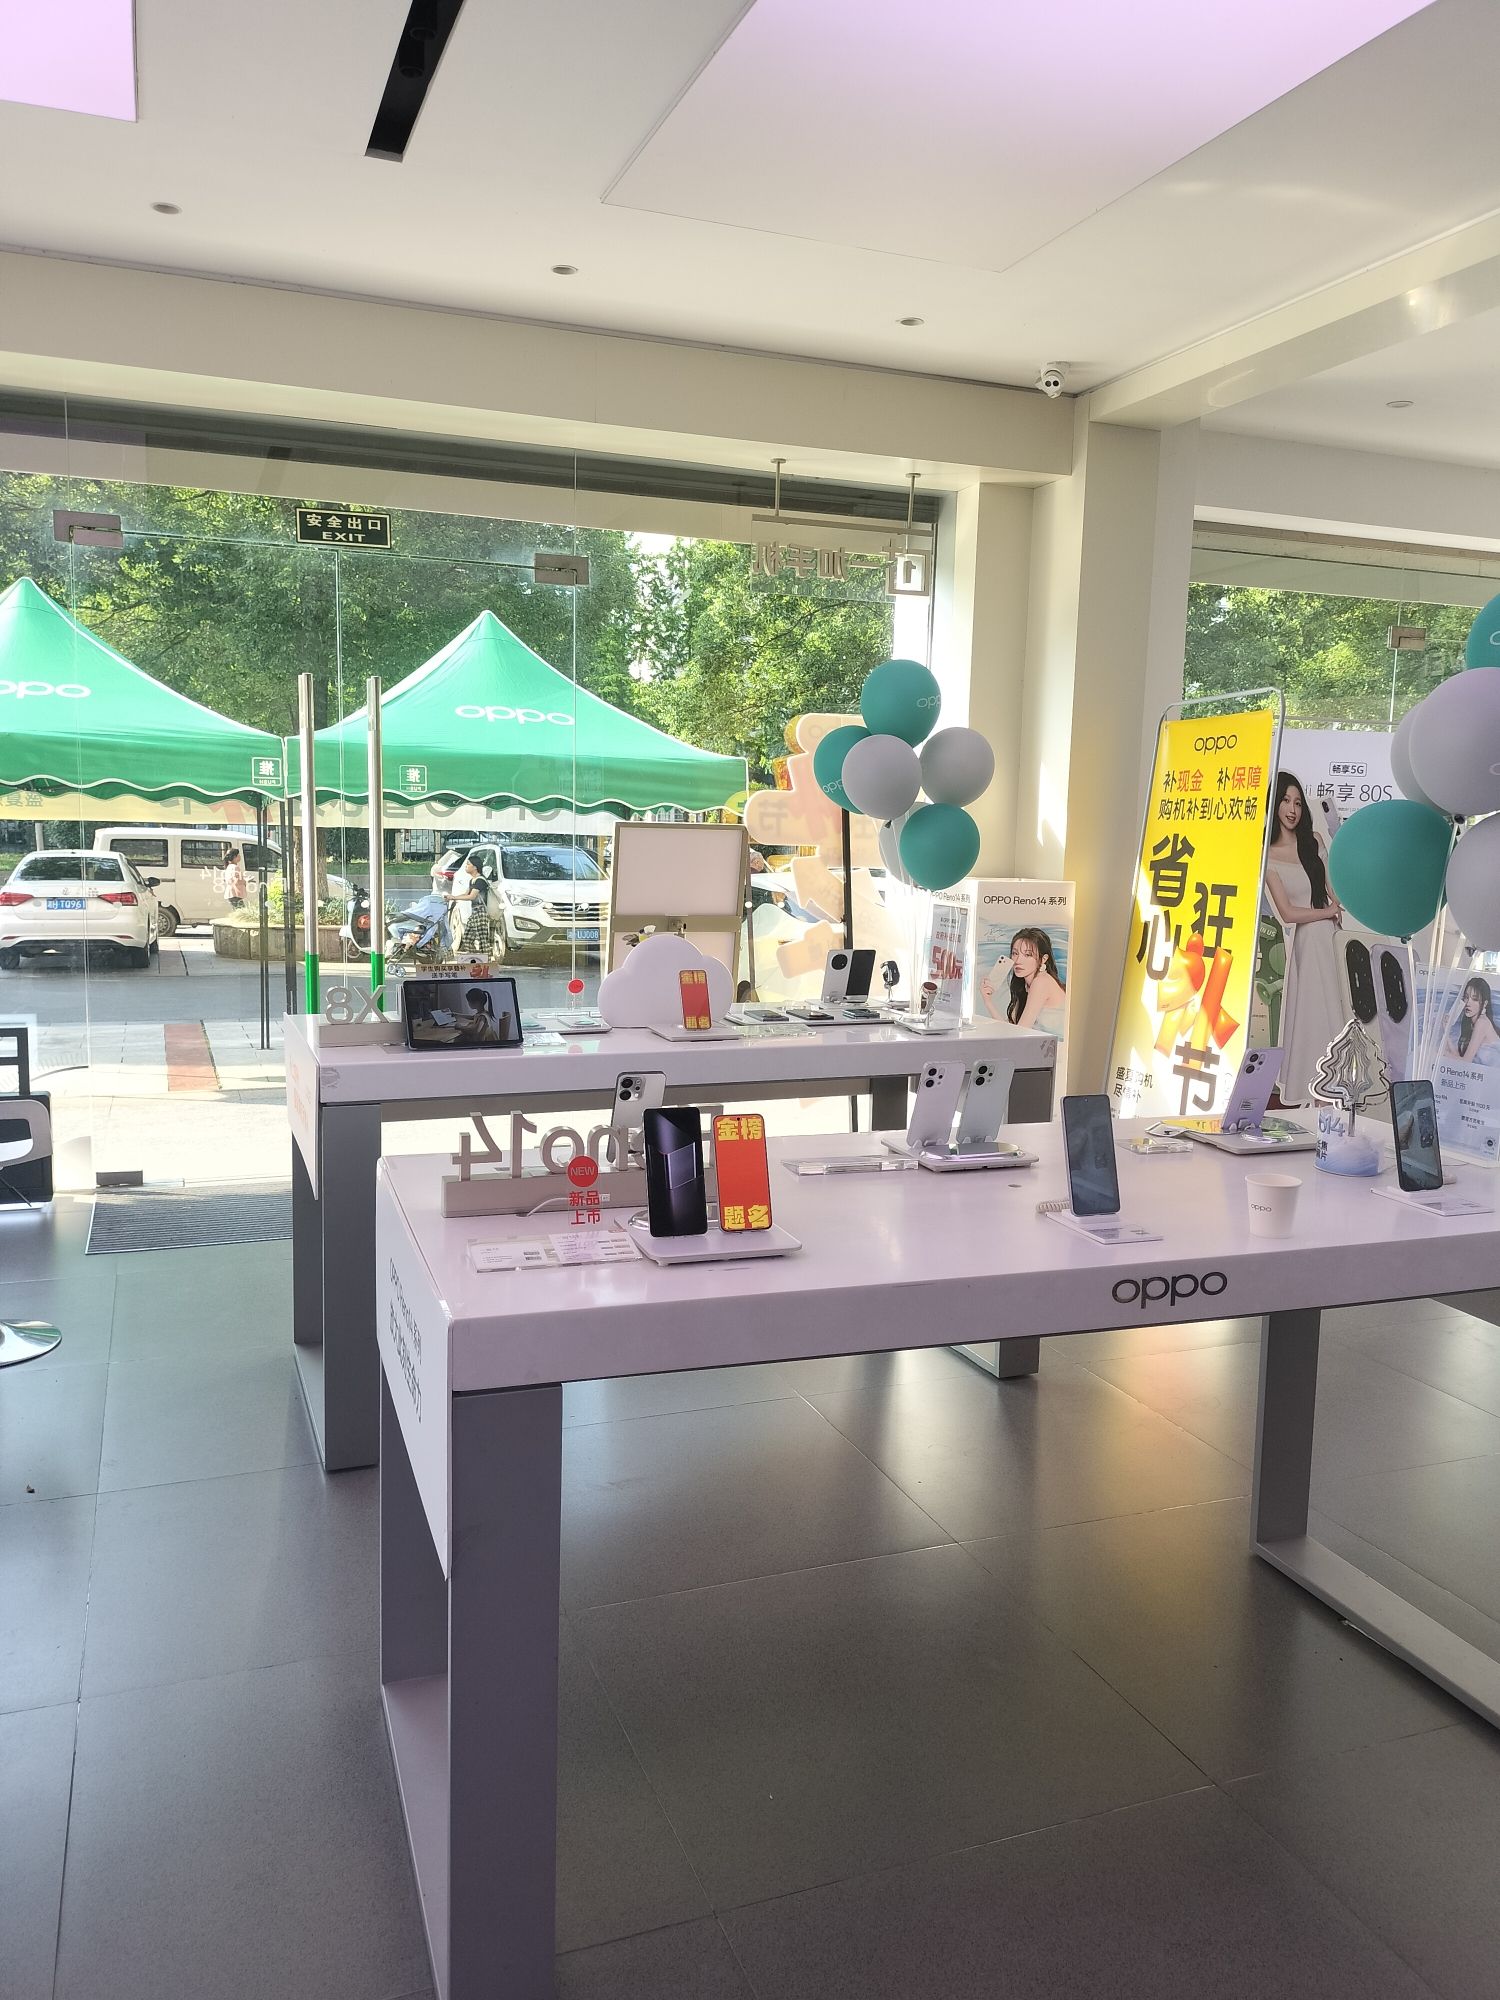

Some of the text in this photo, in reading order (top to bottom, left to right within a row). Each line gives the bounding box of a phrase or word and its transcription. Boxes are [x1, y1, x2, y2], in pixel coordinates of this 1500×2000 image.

[306, 514, 381, 530] 安全出口
[322, 532, 365, 542] EXIT
[1163, 765, 1262, 793] 补现金 补保障
[1317, 782, 1356, 802] 畅享
[1360, 784, 1393, 802] 80S
[1157, 796, 1258, 821] 购机补到心欢畅
[983, 895, 1067, 906] OPPO Reno14 系列
[1441, 1078, 1467, 1091] 新品上市
[718, 1116, 765, 1143] 金榜
[570, 1166, 595, 1177] NEW
[569, 1190, 600, 1207] 新品
[570, 1210, 601, 1226] 上市
[724, 1204, 769, 1230] 题名
